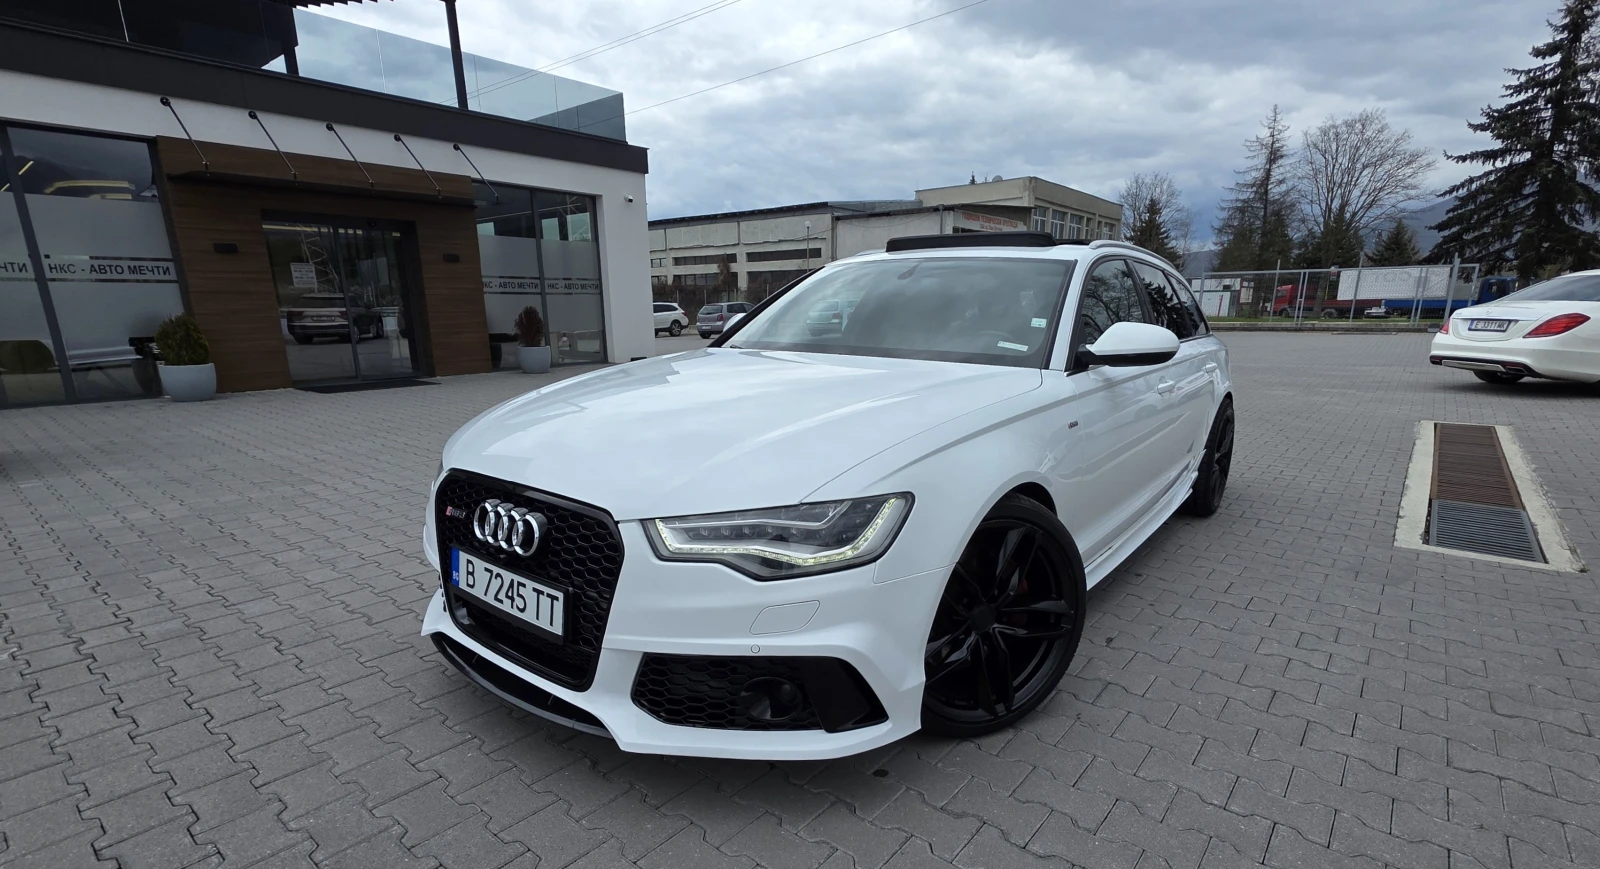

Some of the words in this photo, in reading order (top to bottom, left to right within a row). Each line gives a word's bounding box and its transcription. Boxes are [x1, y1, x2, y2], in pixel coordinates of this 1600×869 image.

[48, 263, 76, 274] НКС
[89, 264, 124, 275] АВТО
[128, 265, 171, 276] МЕЧТИ
[483, 281, 493, 289] КС
[498, 281, 516, 289] АВТО
[517, 282, 539, 290] МЕЧТИ
[547, 282, 560, 290] НКС
[453, 571, 459, 581] BG
[466, 558, 476, 589] B
[484, 567, 527, 613] 7245
[532, 587, 559, 627] TT
